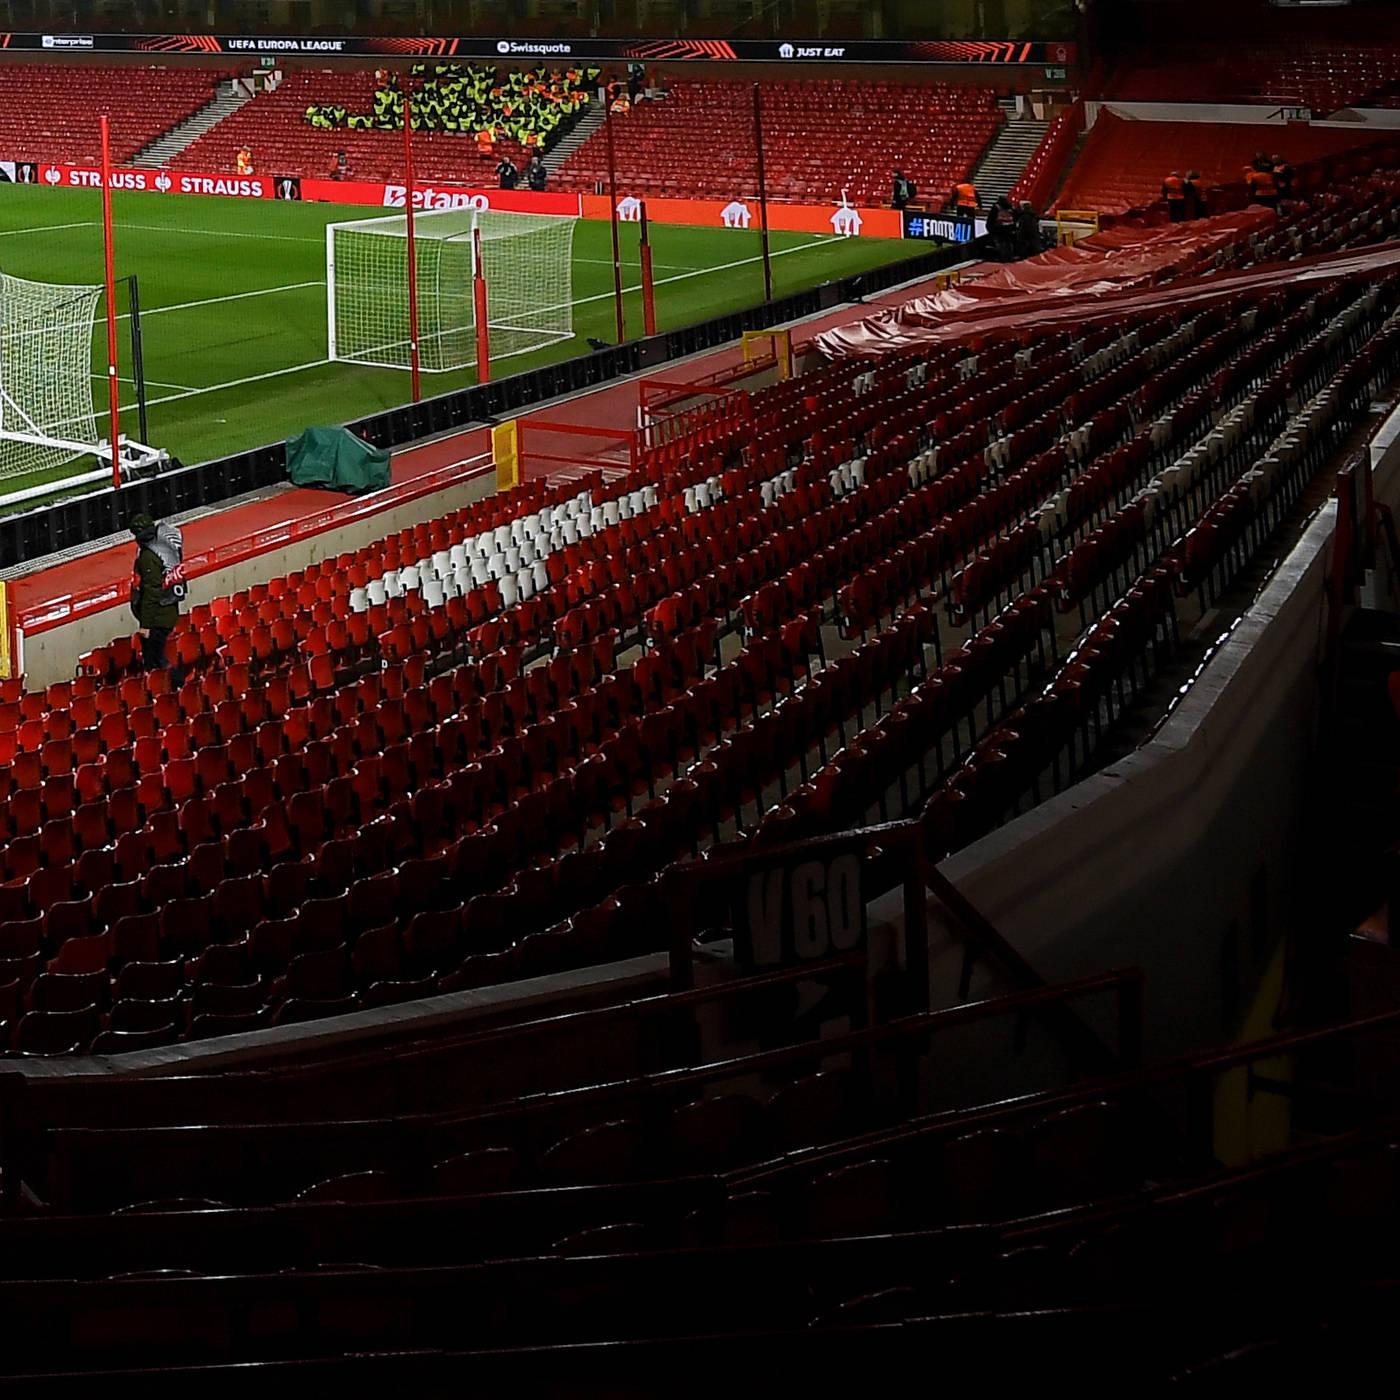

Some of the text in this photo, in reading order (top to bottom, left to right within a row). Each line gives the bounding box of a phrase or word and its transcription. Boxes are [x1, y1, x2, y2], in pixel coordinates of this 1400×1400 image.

[229, 40, 342, 50] UEFA EUROPA LEAGUE
[510, 42, 571, 54] Swissquote
[797, 48, 846, 57] JUST EAT
[70, 171, 262, 197] STRUSS STRAUSS
[383, 185, 489, 213] Betano
[748, 854, 862, 966] V60
